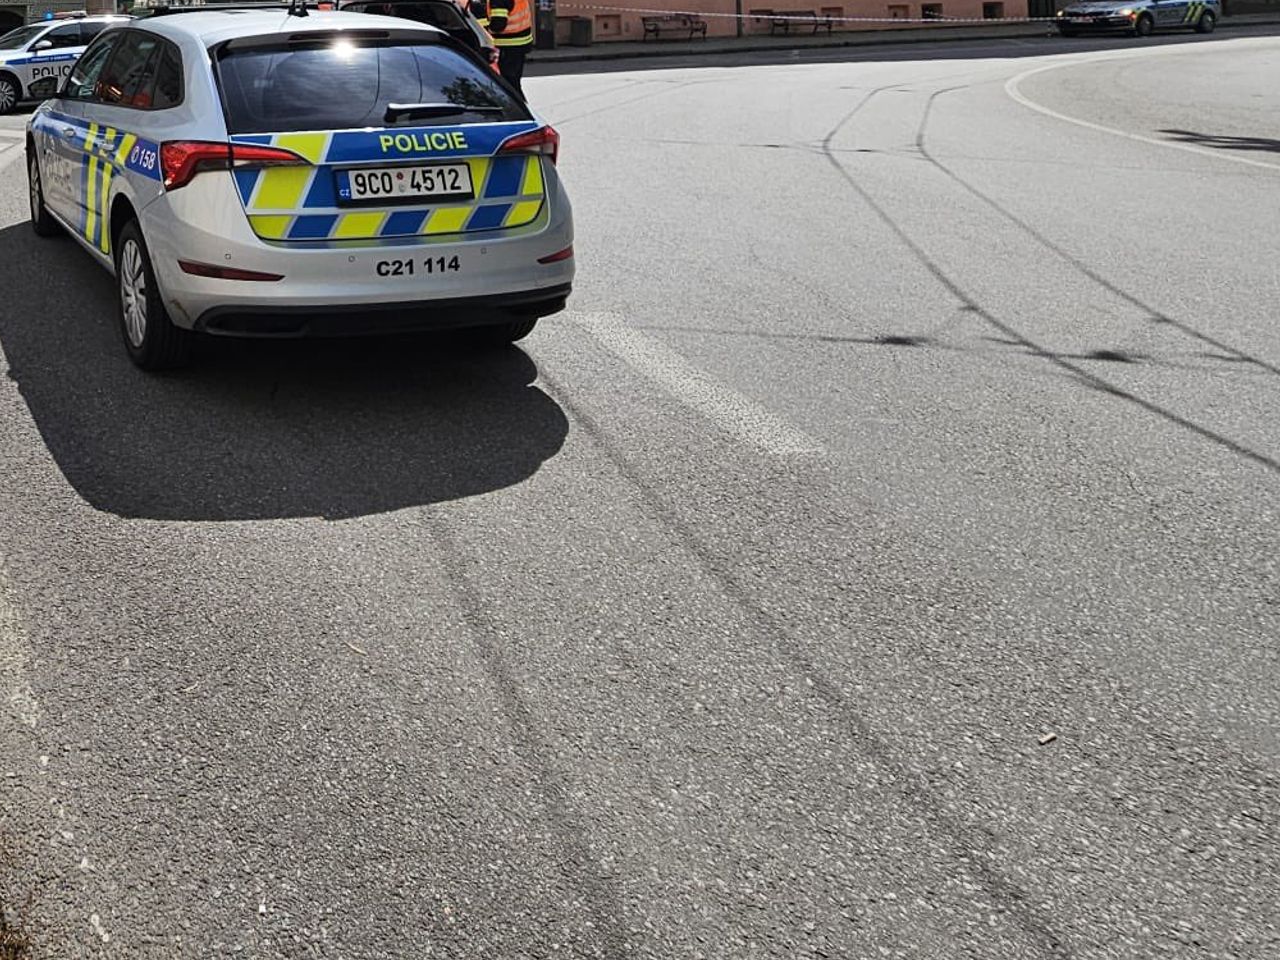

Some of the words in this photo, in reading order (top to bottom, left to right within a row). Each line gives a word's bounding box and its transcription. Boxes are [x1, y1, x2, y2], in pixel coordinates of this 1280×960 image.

[32, 65, 71, 79] POLIC
[379, 131, 468, 153] POLICIE
[139, 147, 156, 170] 158
[410, 168, 462, 192] 4512
[376, 258, 414, 277] C21
[423, 255, 460, 274] 114
